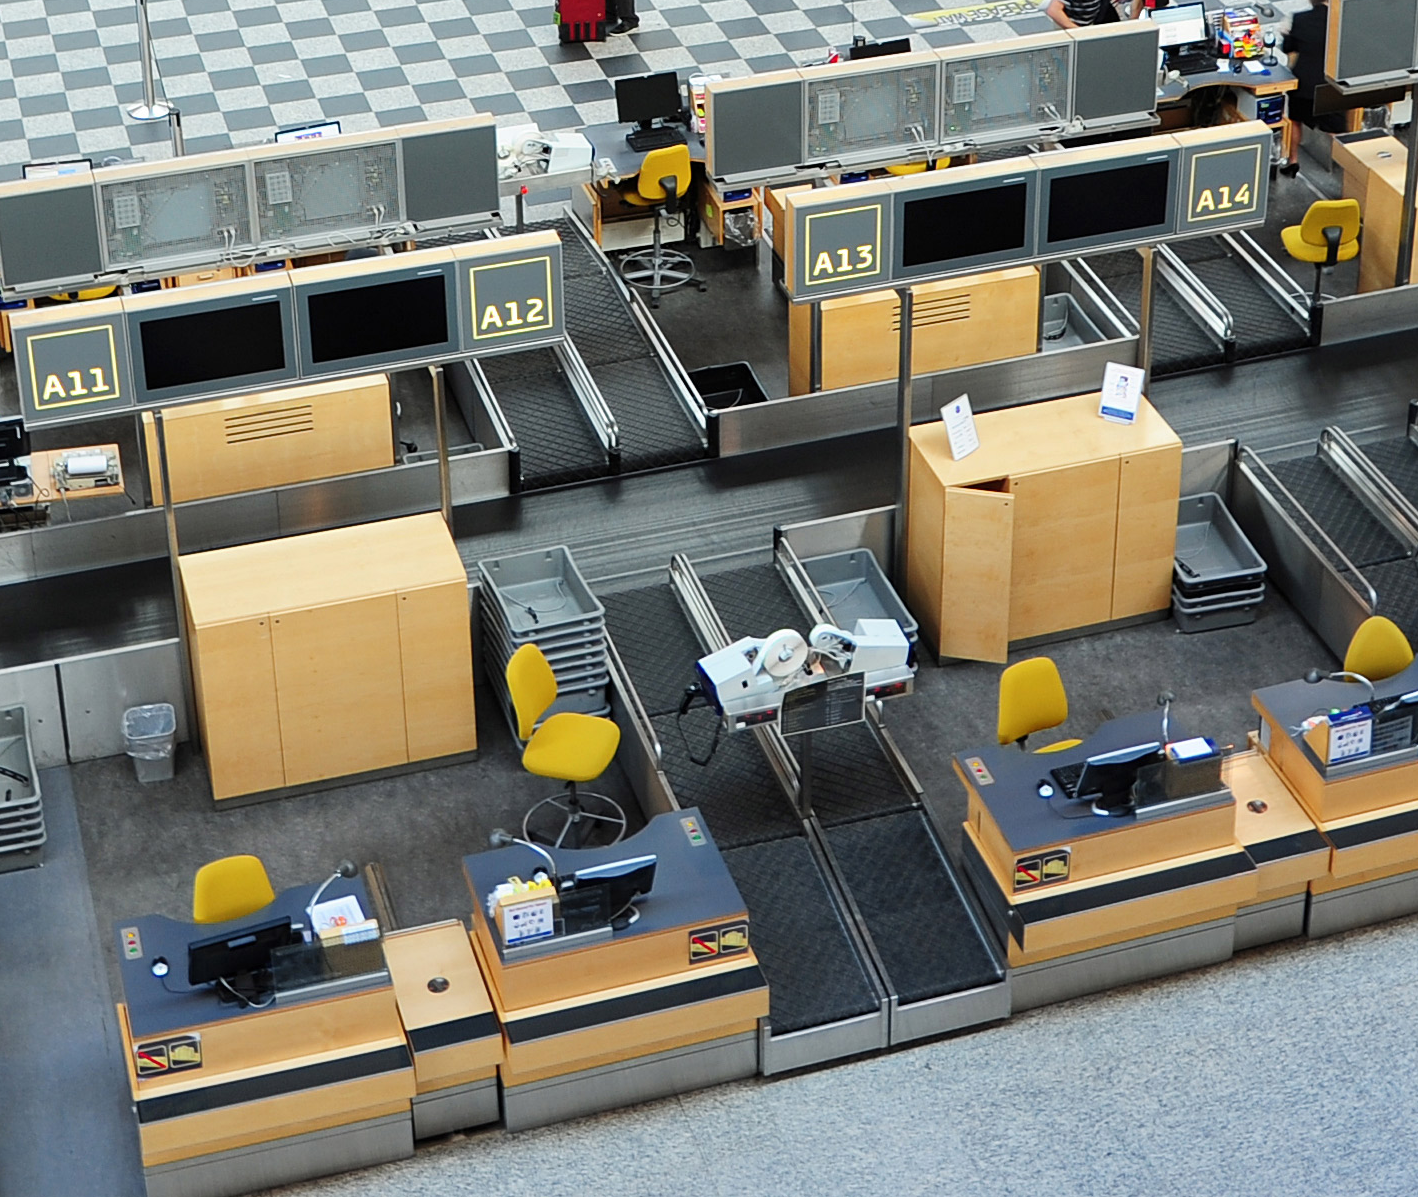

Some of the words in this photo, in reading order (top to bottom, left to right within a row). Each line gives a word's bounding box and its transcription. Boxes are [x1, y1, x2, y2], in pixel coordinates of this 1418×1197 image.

[1195, 183, 1251, 213] A14
[812, 243, 874, 277] A13
[480, 298, 544, 331] A12
[42, 366, 110, 401] A11
